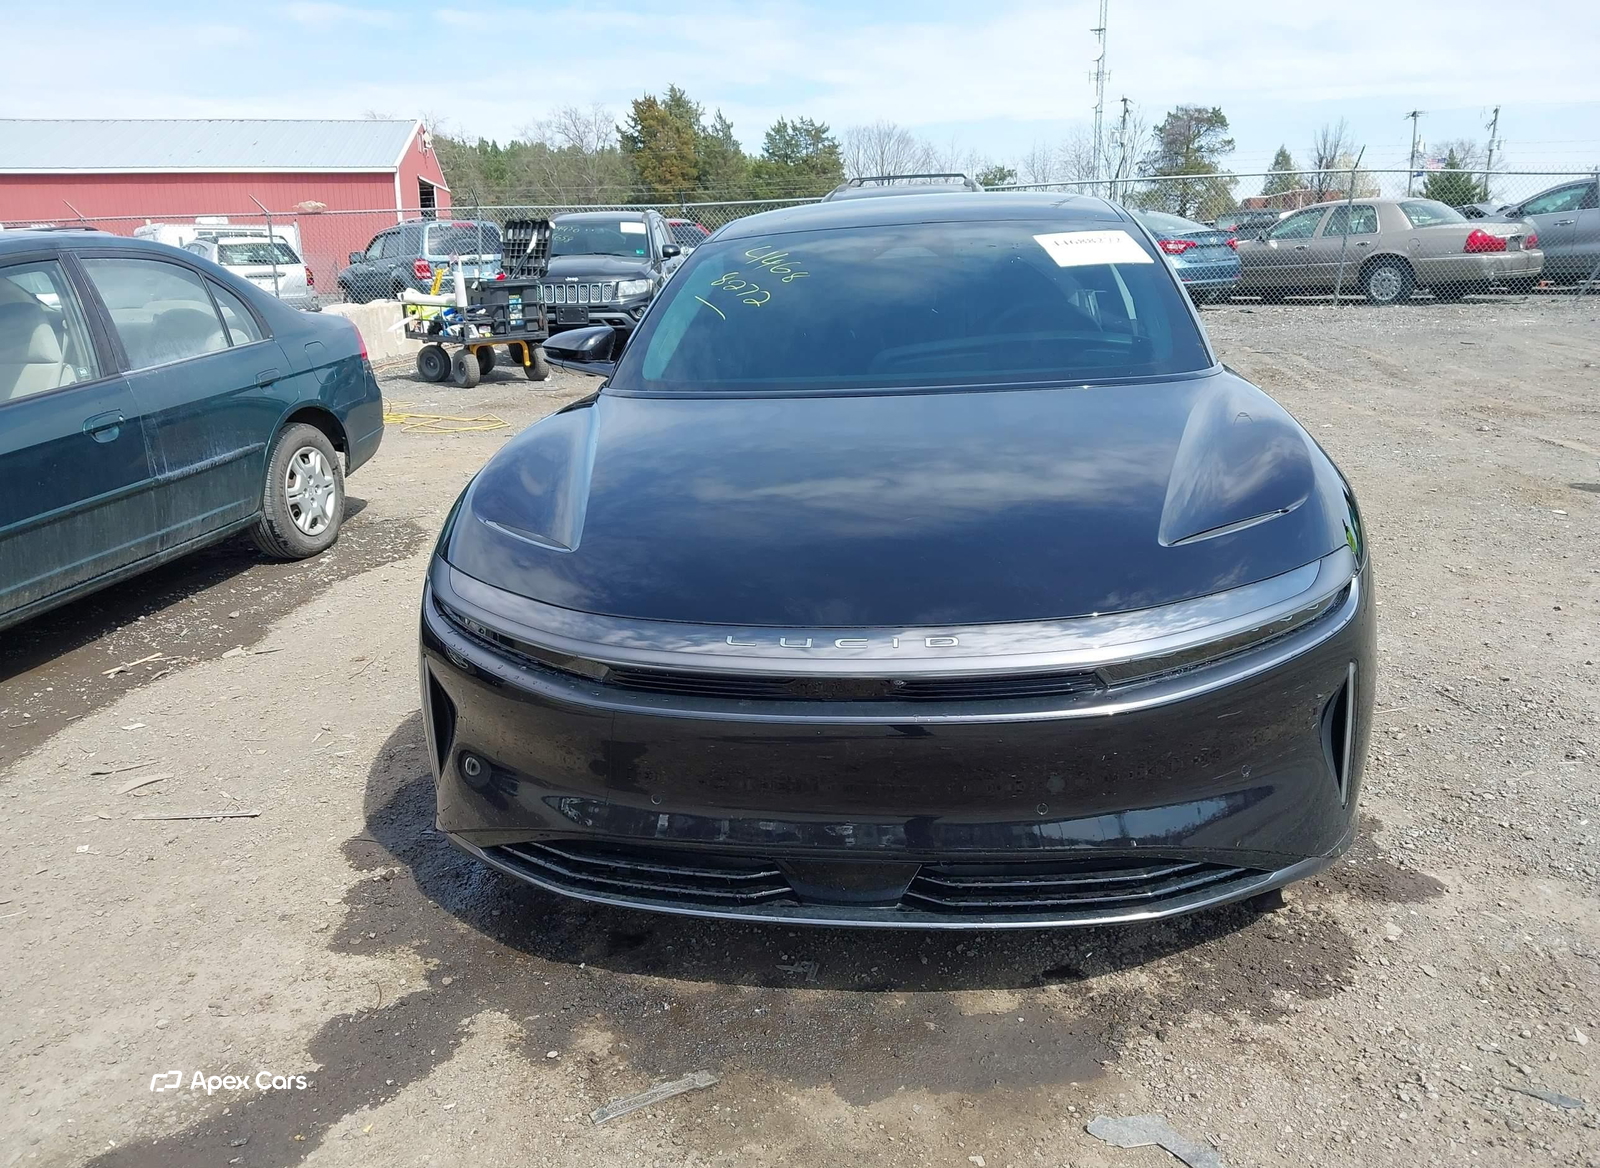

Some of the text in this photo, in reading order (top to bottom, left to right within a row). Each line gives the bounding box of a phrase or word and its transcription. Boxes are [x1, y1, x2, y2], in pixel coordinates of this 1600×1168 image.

[745, 245, 811, 283] 4468
[710, 271, 771, 308] 8272
[726, 635, 960, 649] LUCID
